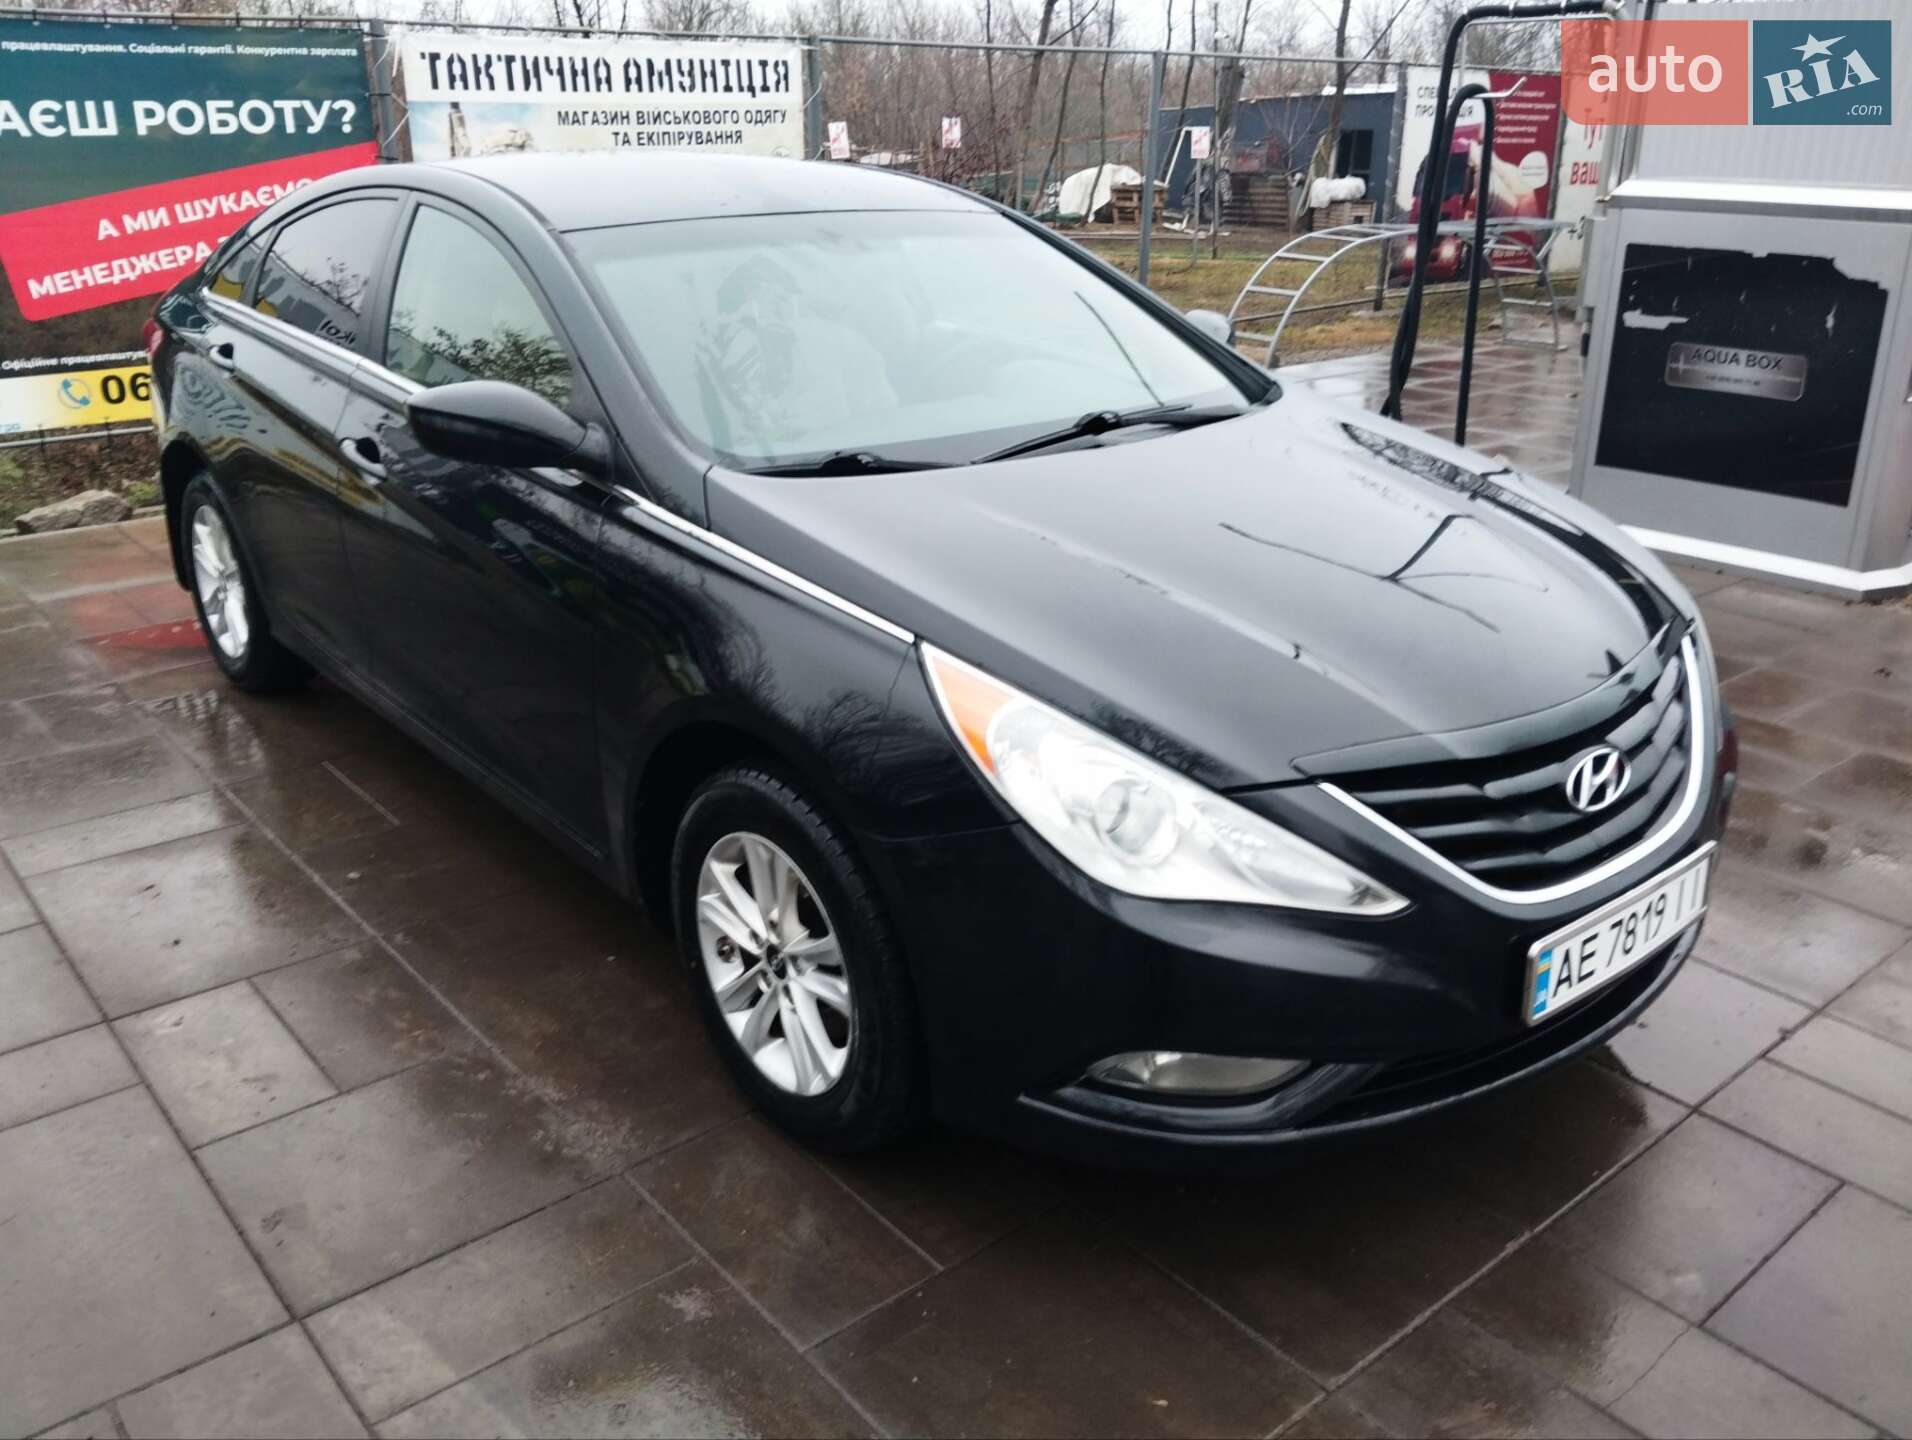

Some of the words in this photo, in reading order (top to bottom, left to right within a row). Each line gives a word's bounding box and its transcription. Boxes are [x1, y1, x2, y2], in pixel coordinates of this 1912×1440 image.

[128, 43, 186, 54] Соціальні
[237, 45, 308, 57] Конкурентна
[310, 47, 358, 58] зарплата
[420, 52, 613, 93] ТАКТИЧНА
[623, 57, 790, 98] АМУНІЦІЯ
[0, 99, 119, 137] АЄШ
[133, 99, 356, 136] РОБОТУ?
[557, 109, 630, 126] МАГАЗИН
[636, 109, 739, 125] ВІЙСЬКОВОГО
[744, 109, 787, 126] ОДЯГУ
[612, 131, 632, 146] ТА
[636, 130, 743, 146] ЕКІПІРУВАННЯ
[97, 218, 120, 241] А
[125, 207, 171, 235] МИ
[27, 240, 215, 300] МЕНЕДЖЕРА
[1690, 349, 1740, 366] AQUA
[1744, 353, 1785, 371] BOX
[1552, 931, 1600, 999] AE
[1606, 892, 1667, 968] 7819
